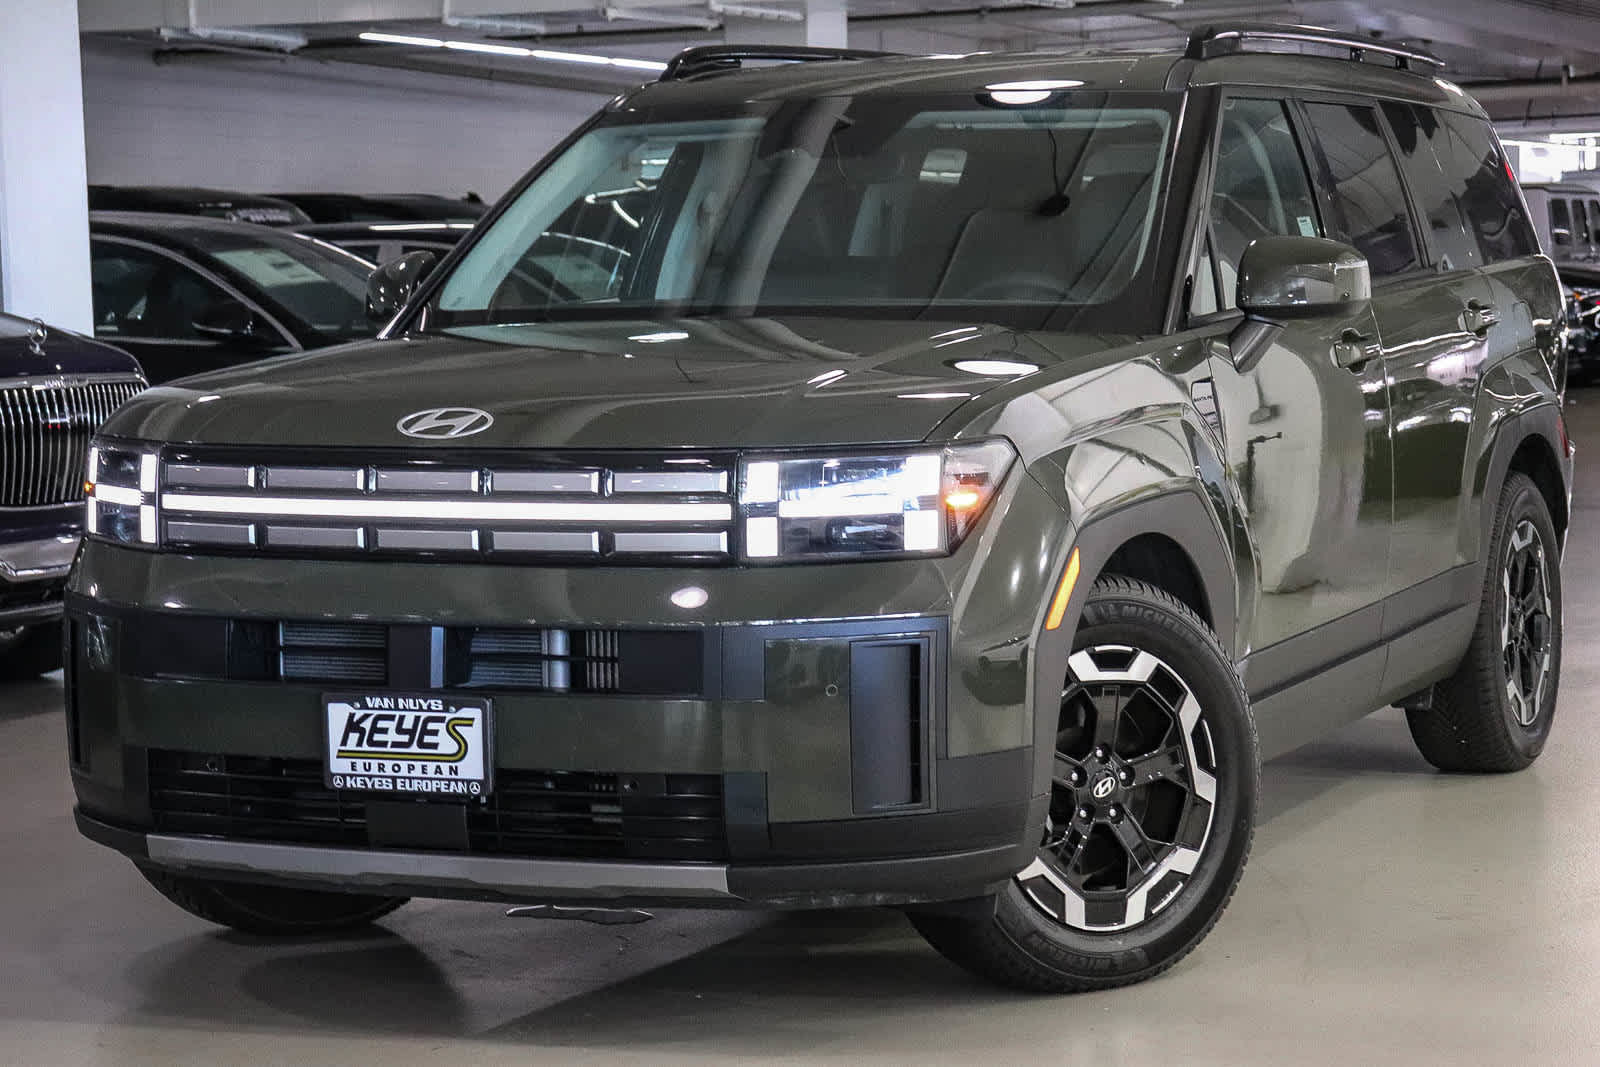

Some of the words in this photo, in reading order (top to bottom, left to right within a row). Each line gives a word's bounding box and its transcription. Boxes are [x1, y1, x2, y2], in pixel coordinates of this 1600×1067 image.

[365, 696, 394, 709] VAN
[398, 698, 443, 710] NUYS
[338, 712, 475, 762] KEYES
[350, 762, 459, 776] EUROPEAN
[346, 776, 393, 790] KEYES
[396, 778, 467, 793] EUROPEAN
